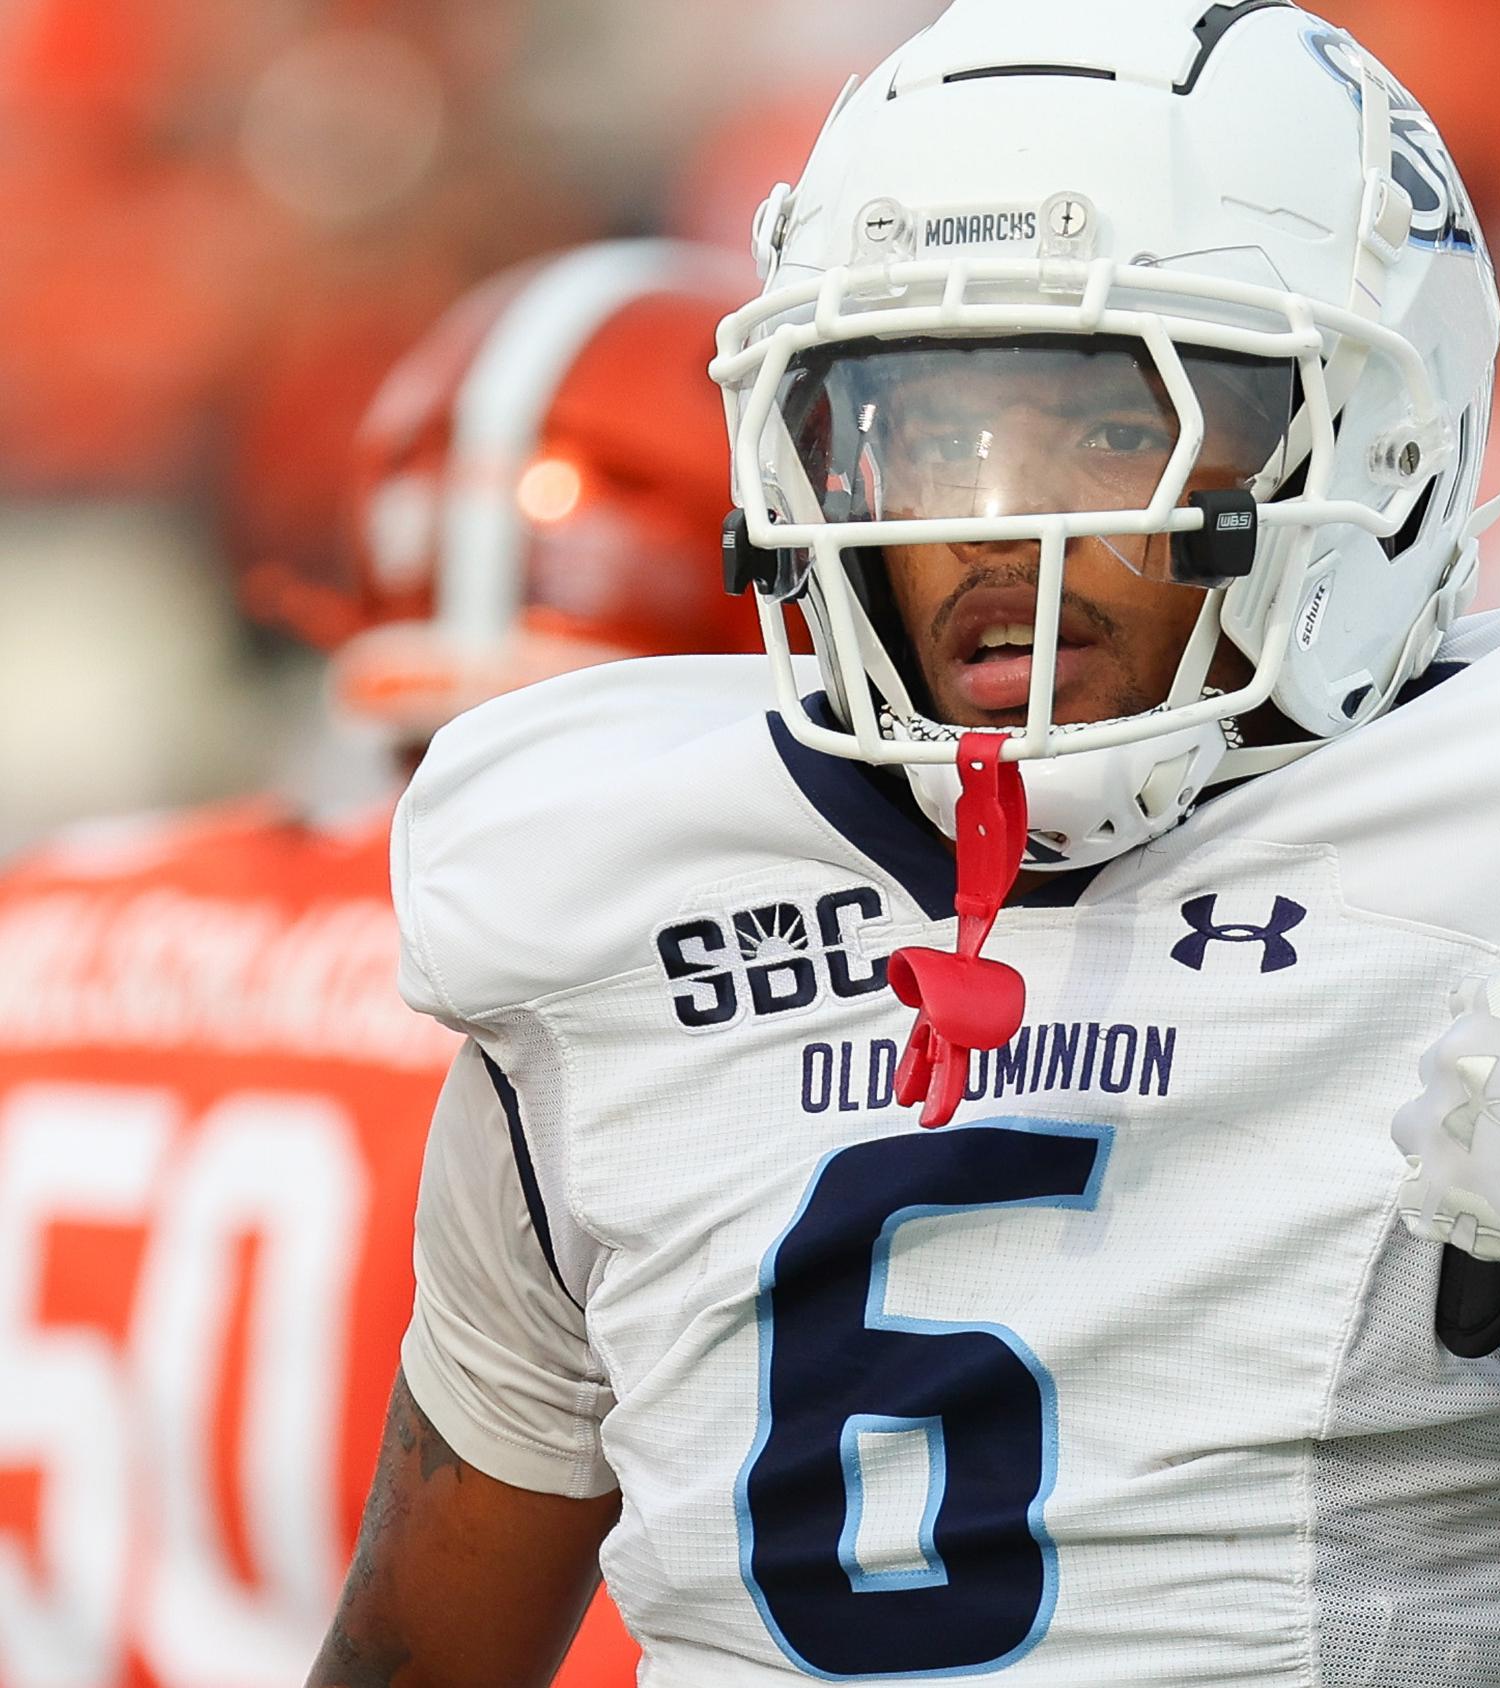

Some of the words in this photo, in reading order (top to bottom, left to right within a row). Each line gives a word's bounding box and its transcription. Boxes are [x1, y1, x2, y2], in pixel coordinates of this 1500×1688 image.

[923, 210, 1036, 248] MONARCHS
[1219, 513, 1250, 528] WBS
[656, 886, 896, 1028] SBC
[801, 1038, 897, 1112] OLD
[962, 1023, 1176, 1101] OMINION
[734, 1116, 1116, 1683] 6
